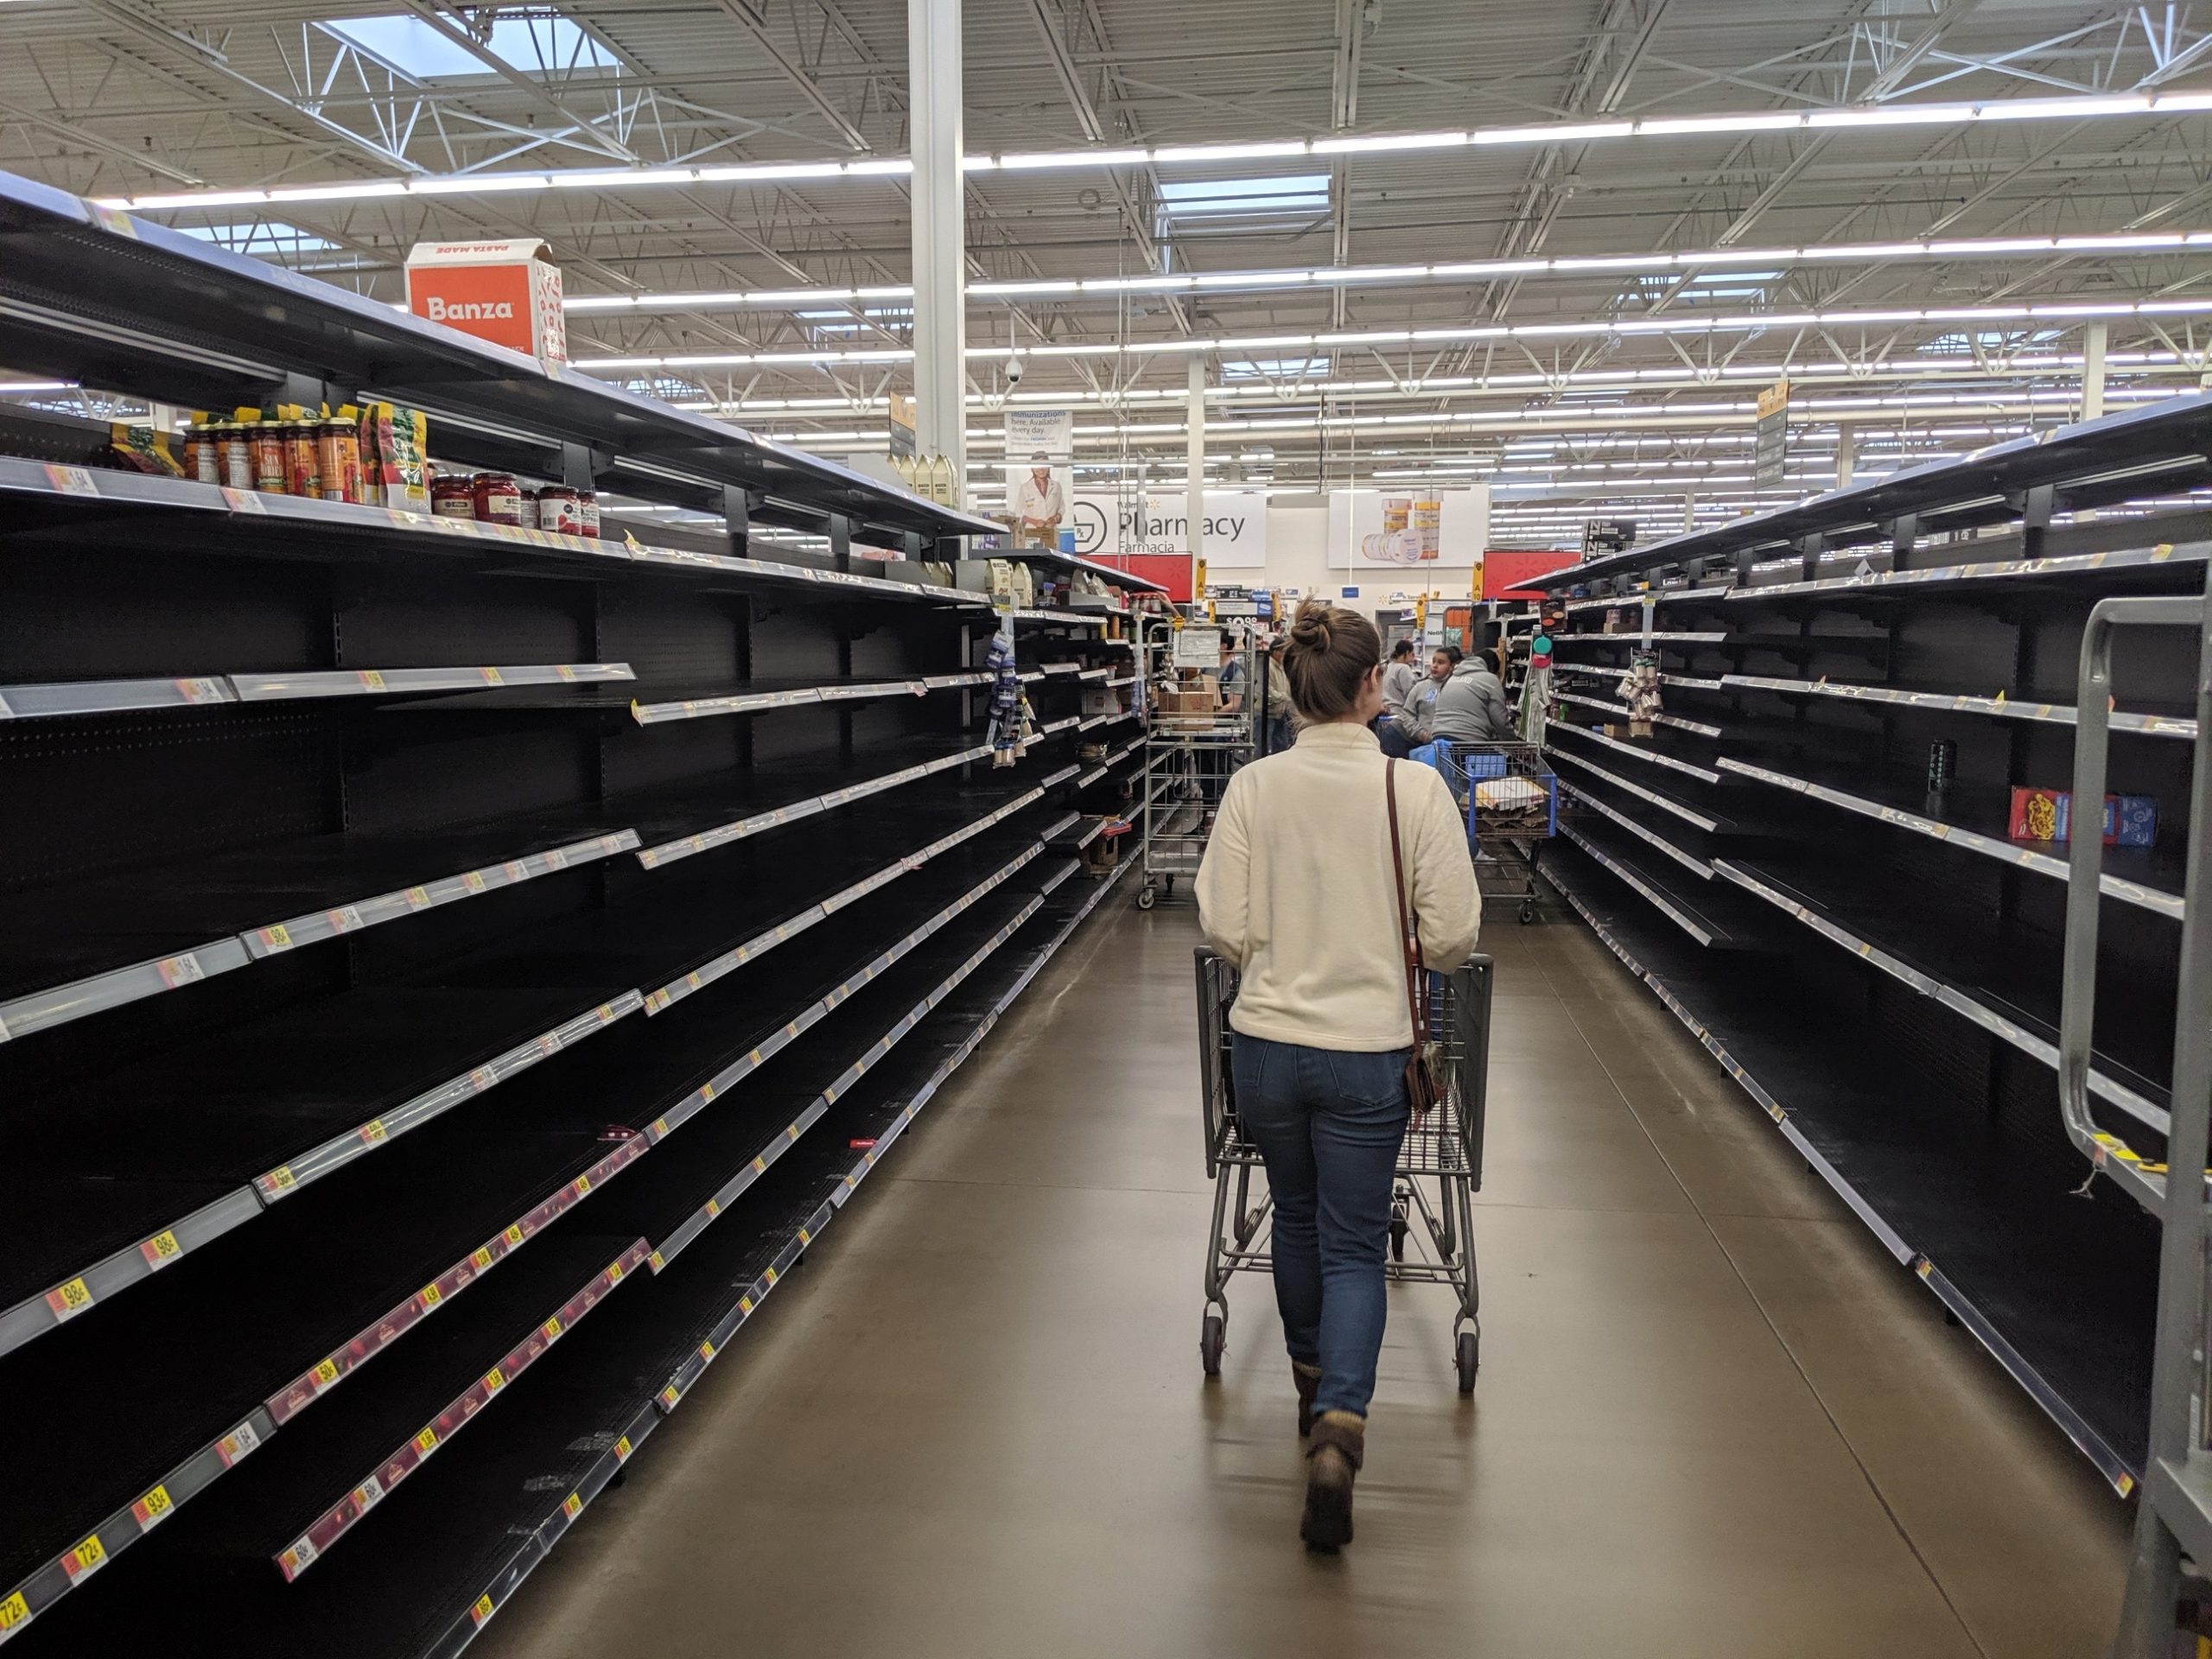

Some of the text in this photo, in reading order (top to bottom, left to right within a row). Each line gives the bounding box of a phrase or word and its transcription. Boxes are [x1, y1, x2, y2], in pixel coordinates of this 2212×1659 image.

[427, 296, 512, 321] Banza
[1120, 541, 1175, 554] Farmacia
[64, 1284, 85, 1305] 98¢
[147, 1492, 166, 1513] 93¢
[78, 1542, 99, 1565] 72¢
[0, 1600, 22, 1624] 72¢
